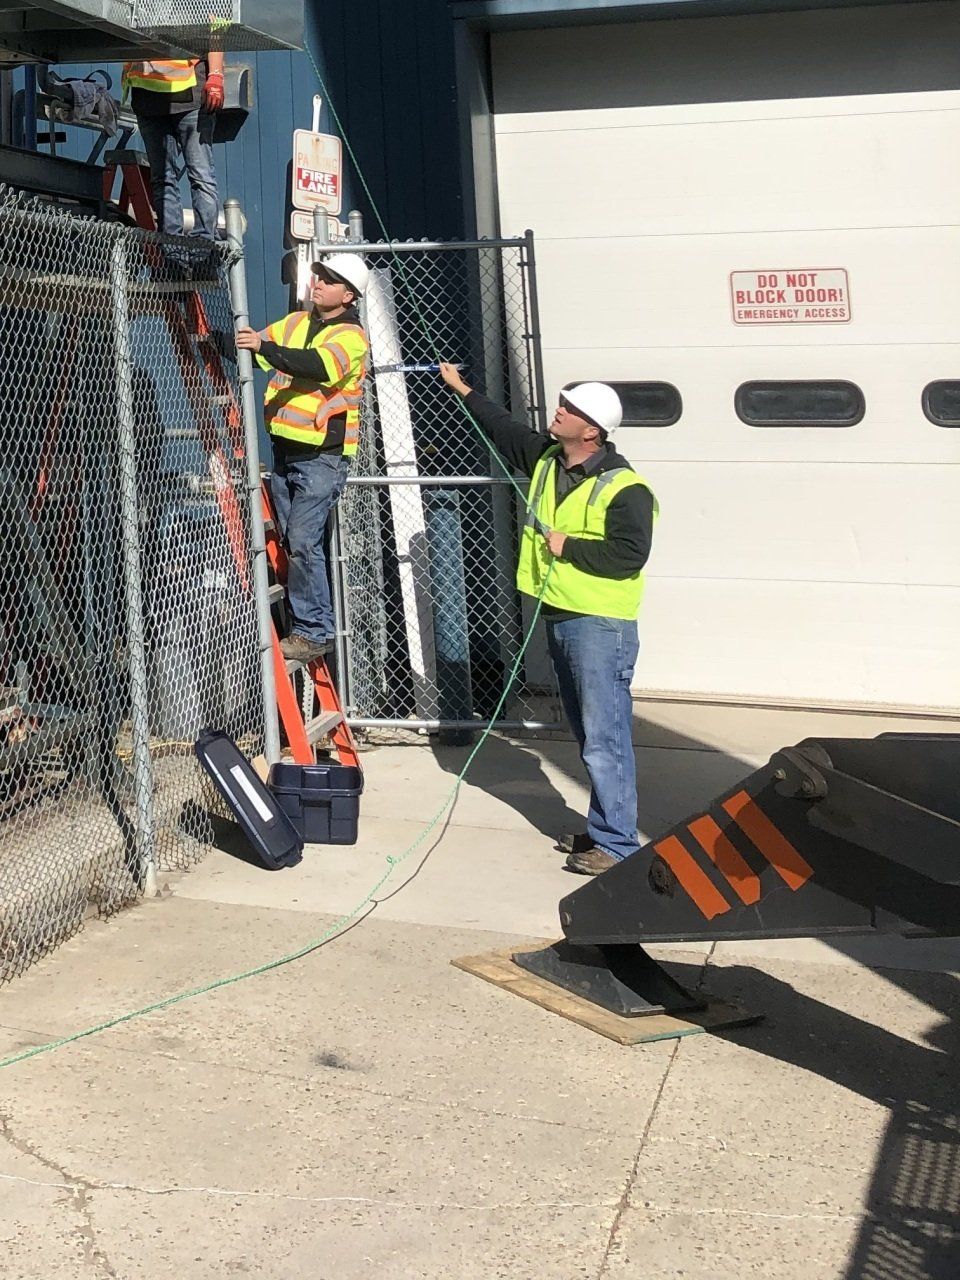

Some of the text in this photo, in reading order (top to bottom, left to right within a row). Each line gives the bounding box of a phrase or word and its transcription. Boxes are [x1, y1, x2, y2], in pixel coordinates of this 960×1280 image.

[301, 168, 333, 184] FIRE
[298, 180, 336, 196] LANE
[757, 273, 817, 288] DO NOT
[736, 288, 844, 304] BLOCK DOOR!
[737, 307, 846, 319] EMERGENCY ACCESS
